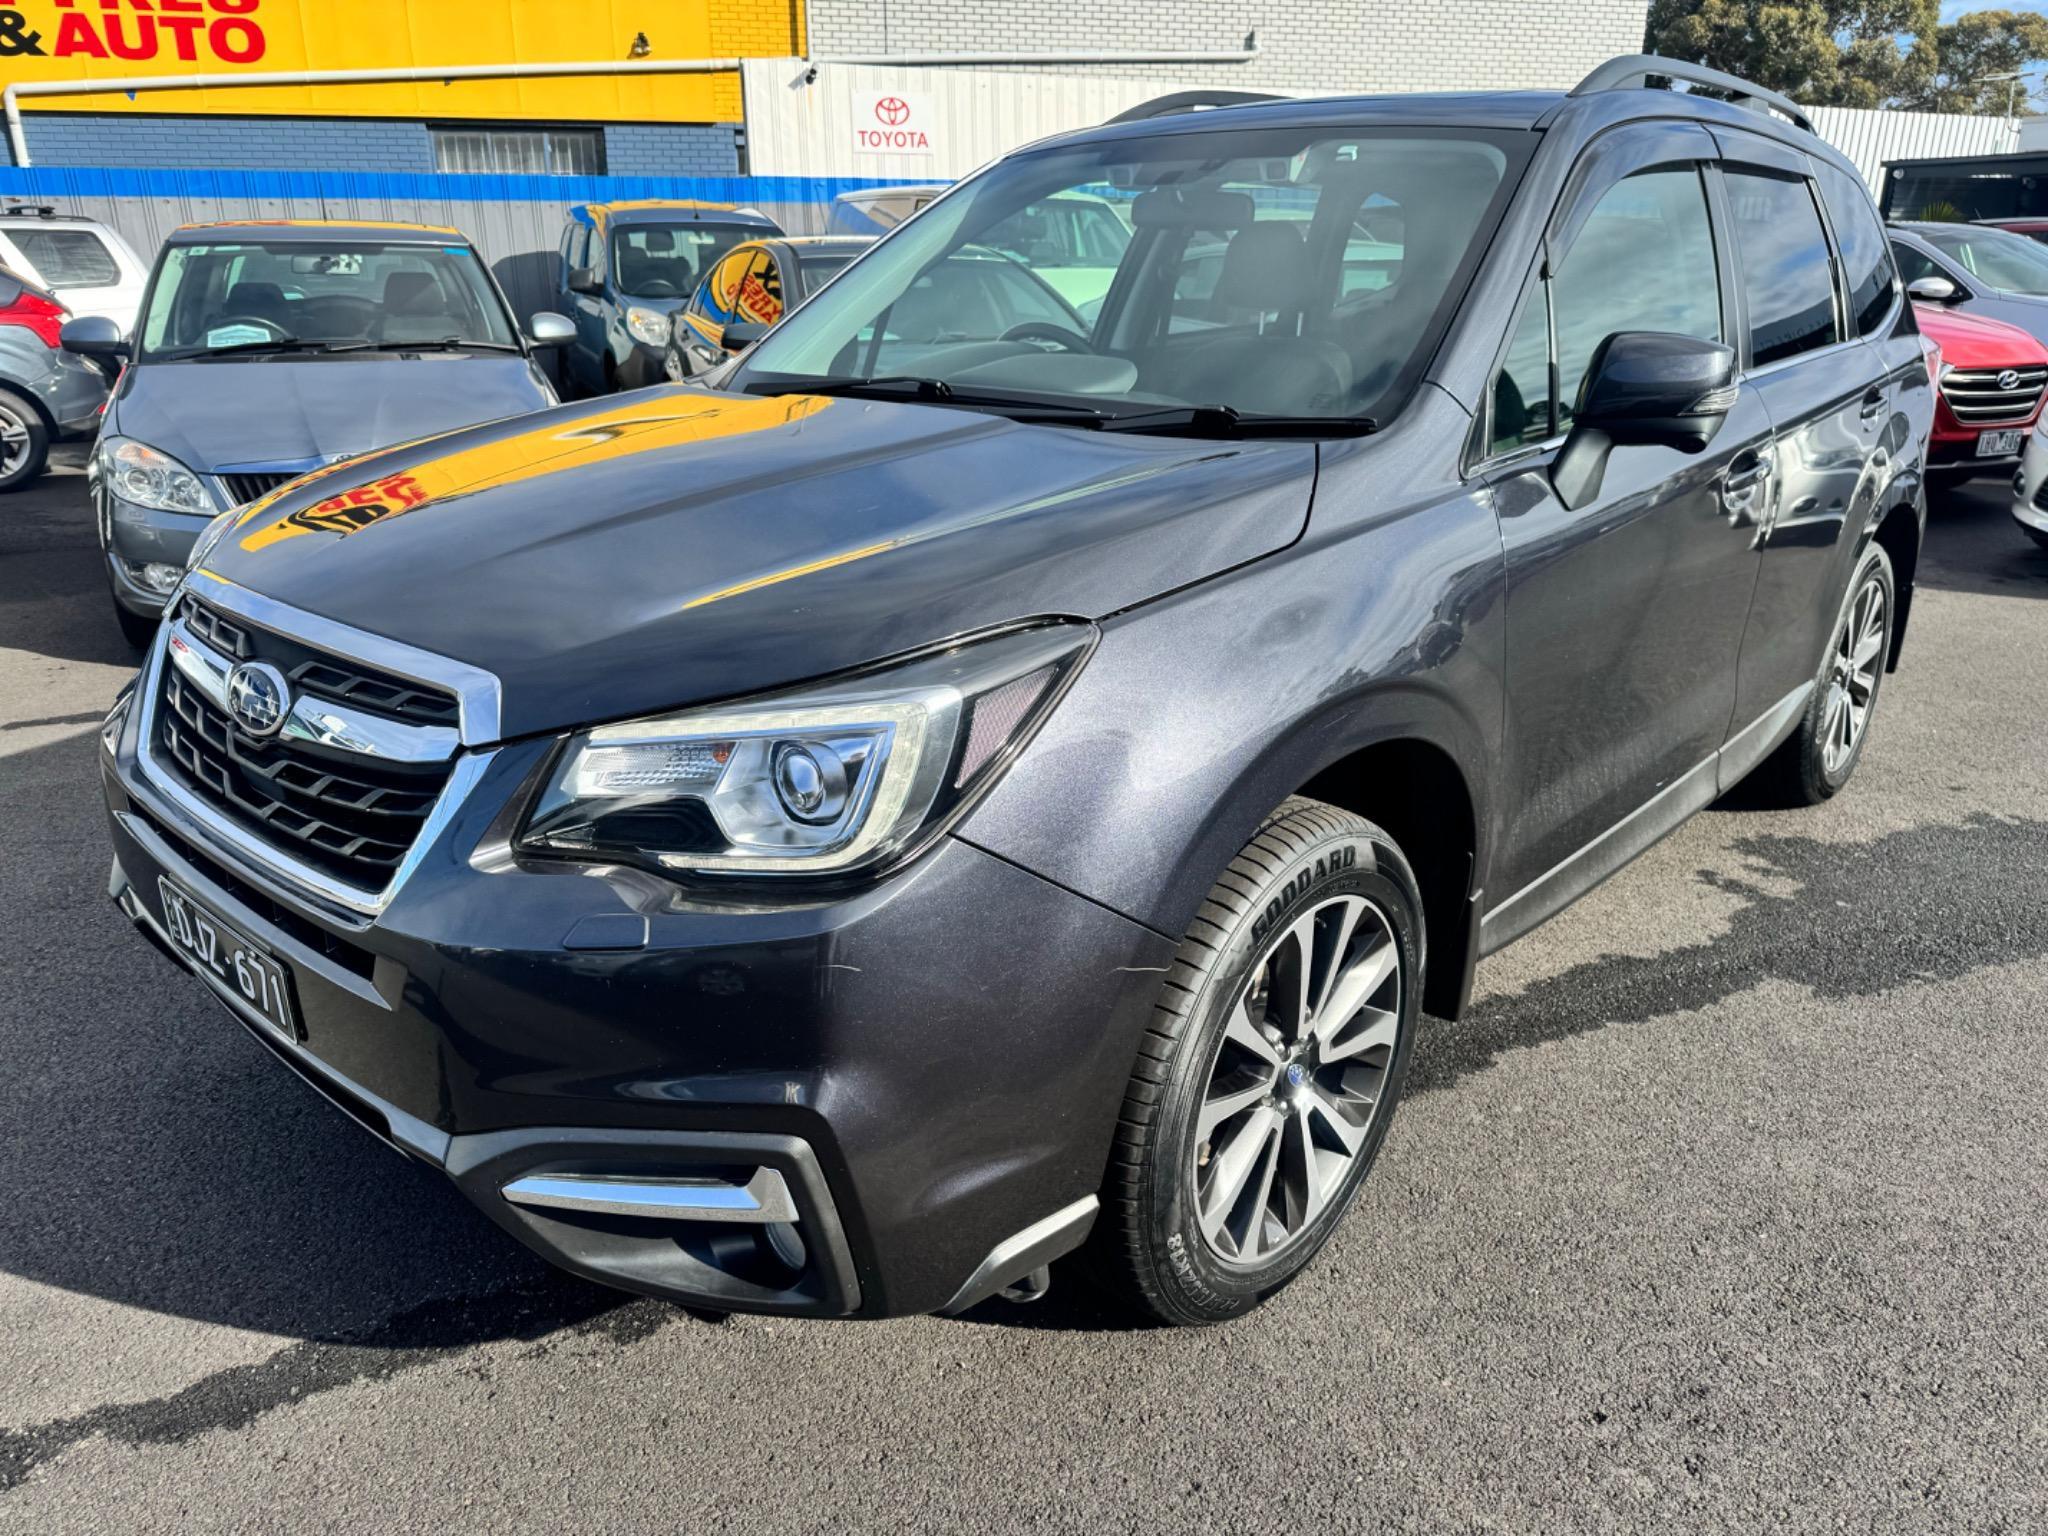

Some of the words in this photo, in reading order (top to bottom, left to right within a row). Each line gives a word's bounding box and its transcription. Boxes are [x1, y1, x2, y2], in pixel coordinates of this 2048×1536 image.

[0, 9, 49, 57] &
[53, 11, 266, 64] AUTO
[857, 130, 929, 148] TOYOTA
